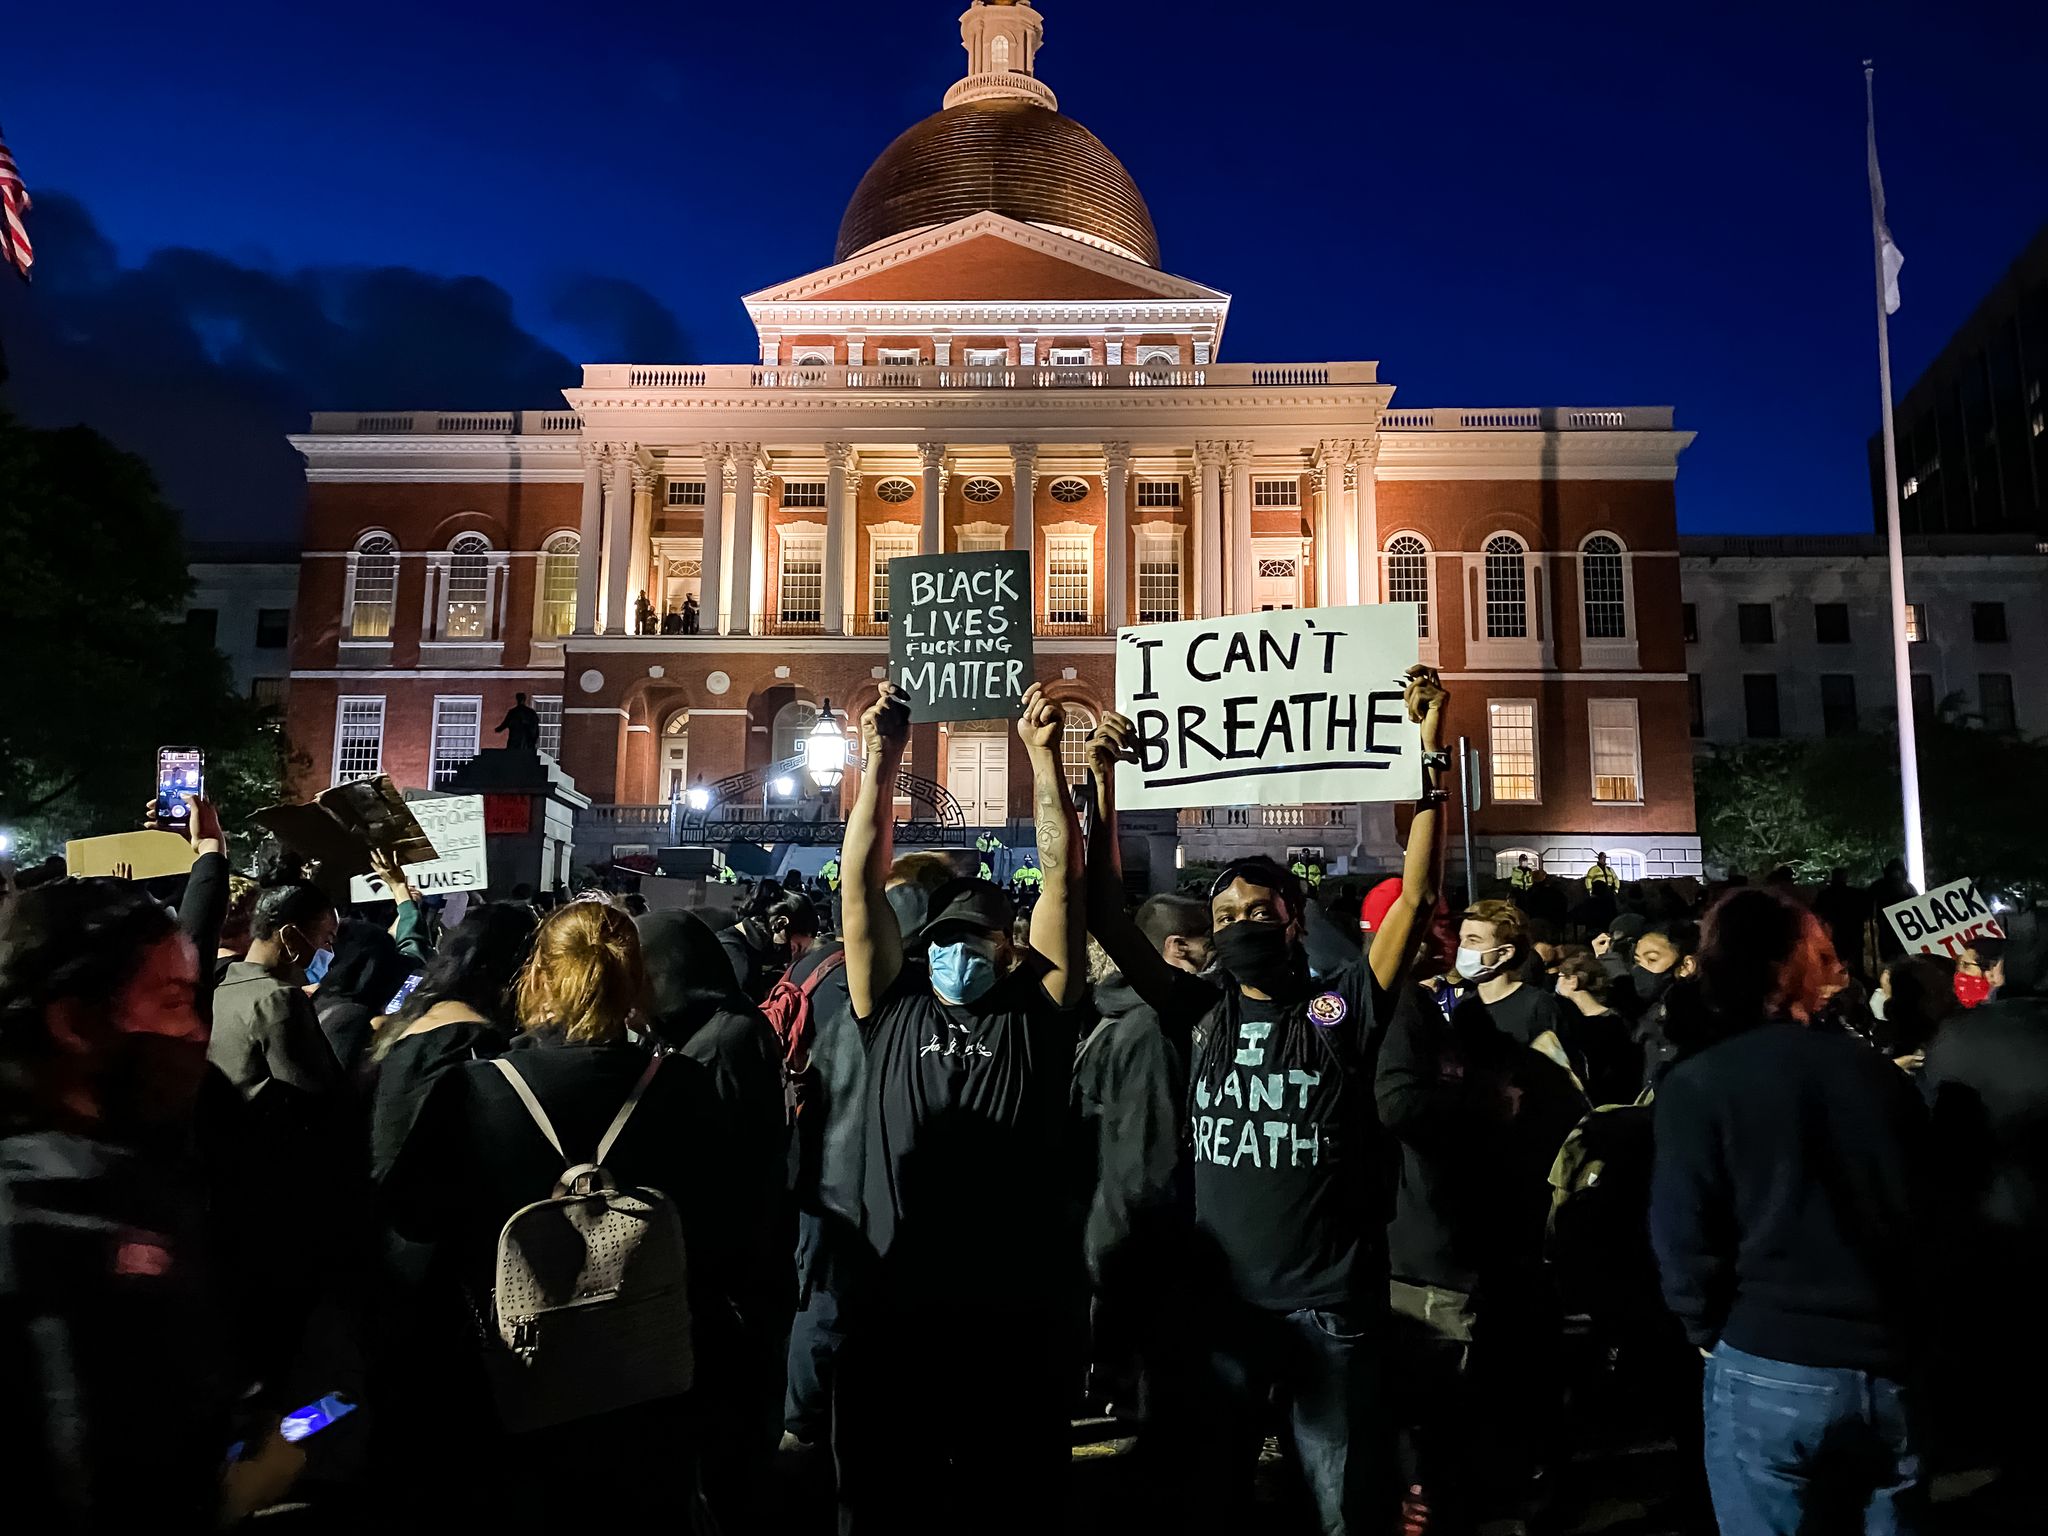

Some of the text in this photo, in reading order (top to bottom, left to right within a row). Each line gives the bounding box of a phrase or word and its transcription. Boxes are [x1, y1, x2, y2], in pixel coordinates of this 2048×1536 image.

[911, 569, 1019, 605] BLACK
[903, 605, 1009, 637] LIVES
[906, 636, 1012, 656] FUCKING
[1186, 619, 1347, 682] CAN'T
[900, 660, 1024, 706] MATTER
[1895, 882, 1987, 941] BLACK
[1234, 1022, 1272, 1067] I
